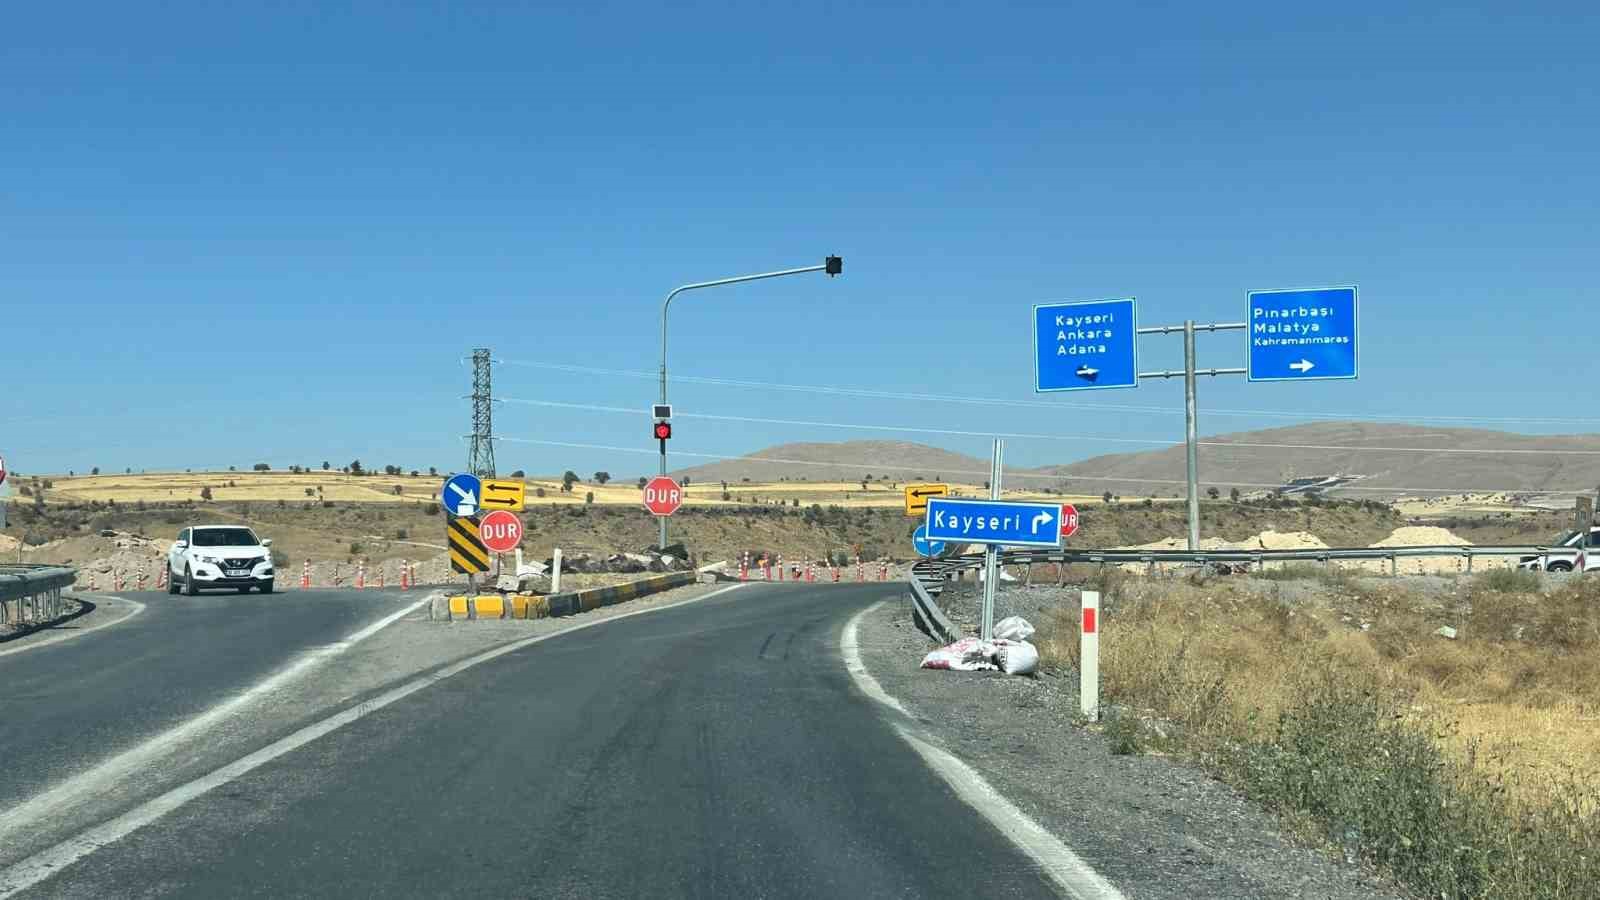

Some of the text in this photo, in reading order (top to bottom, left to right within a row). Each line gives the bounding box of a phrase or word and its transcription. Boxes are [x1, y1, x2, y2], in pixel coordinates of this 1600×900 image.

[1056, 313, 1113, 328] Kayseri
[1057, 328, 1112, 341] Ankara
[1254, 322, 1320, 335] Malatya
[1057, 344, 1106, 356] Adana
[645, 488, 679, 504] DUR
[935, 510, 1020, 534] Kayseri
[1062, 513, 1077, 528] UR
[484, 524, 518, 541] DUR
